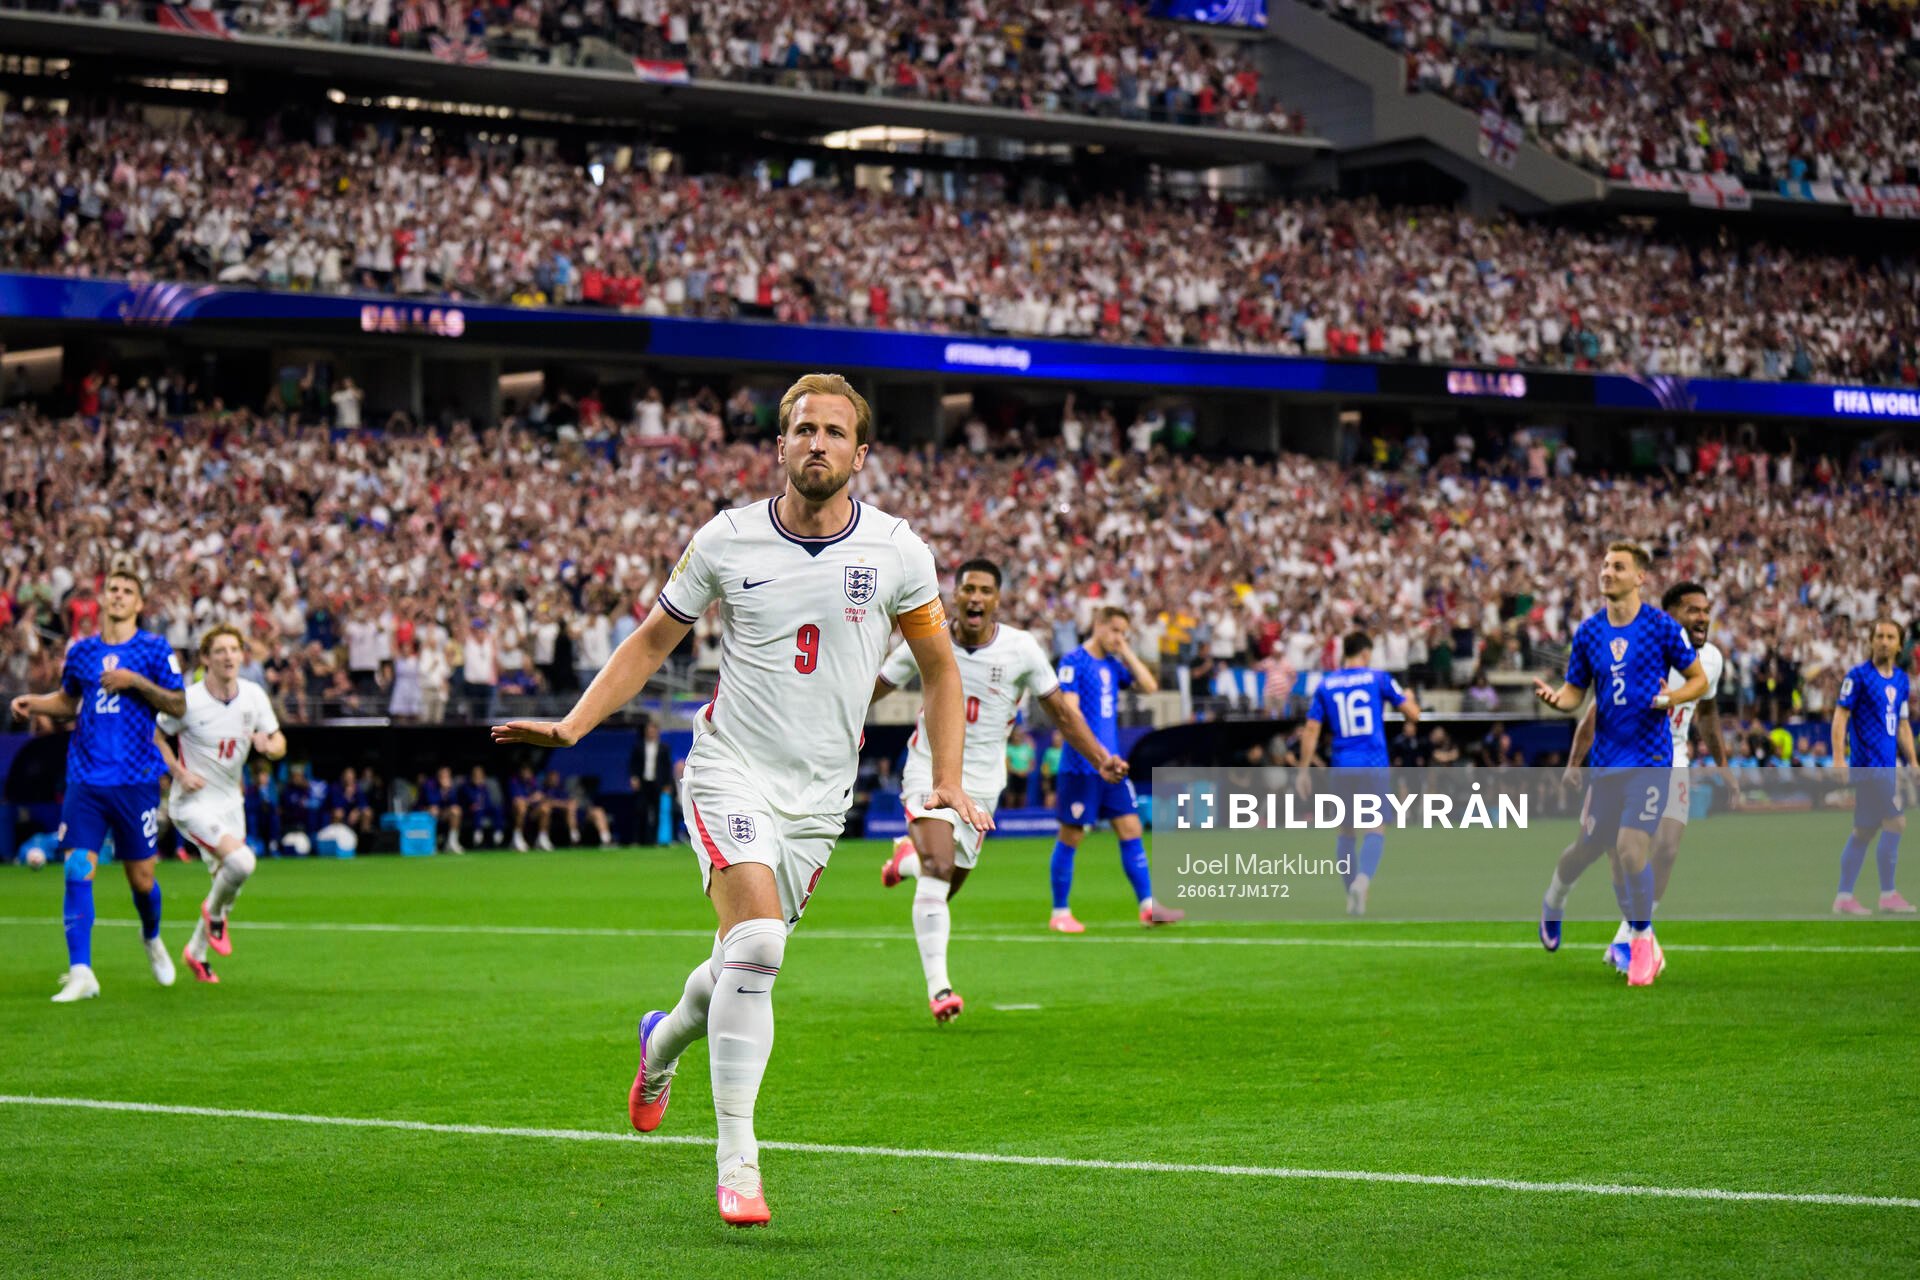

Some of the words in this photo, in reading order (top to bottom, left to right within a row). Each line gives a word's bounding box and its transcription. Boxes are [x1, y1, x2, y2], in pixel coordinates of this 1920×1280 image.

[1833, 390, 1870, 414] FIFA
[1870, 392, 1920, 416] WORL
[794, 623, 820, 674] 9
[95, 687, 120, 714] 22
[1612, 678, 1627, 705] 2
[1333, 689, 1373, 738] 16
[1645, 786, 1660, 815] 2
